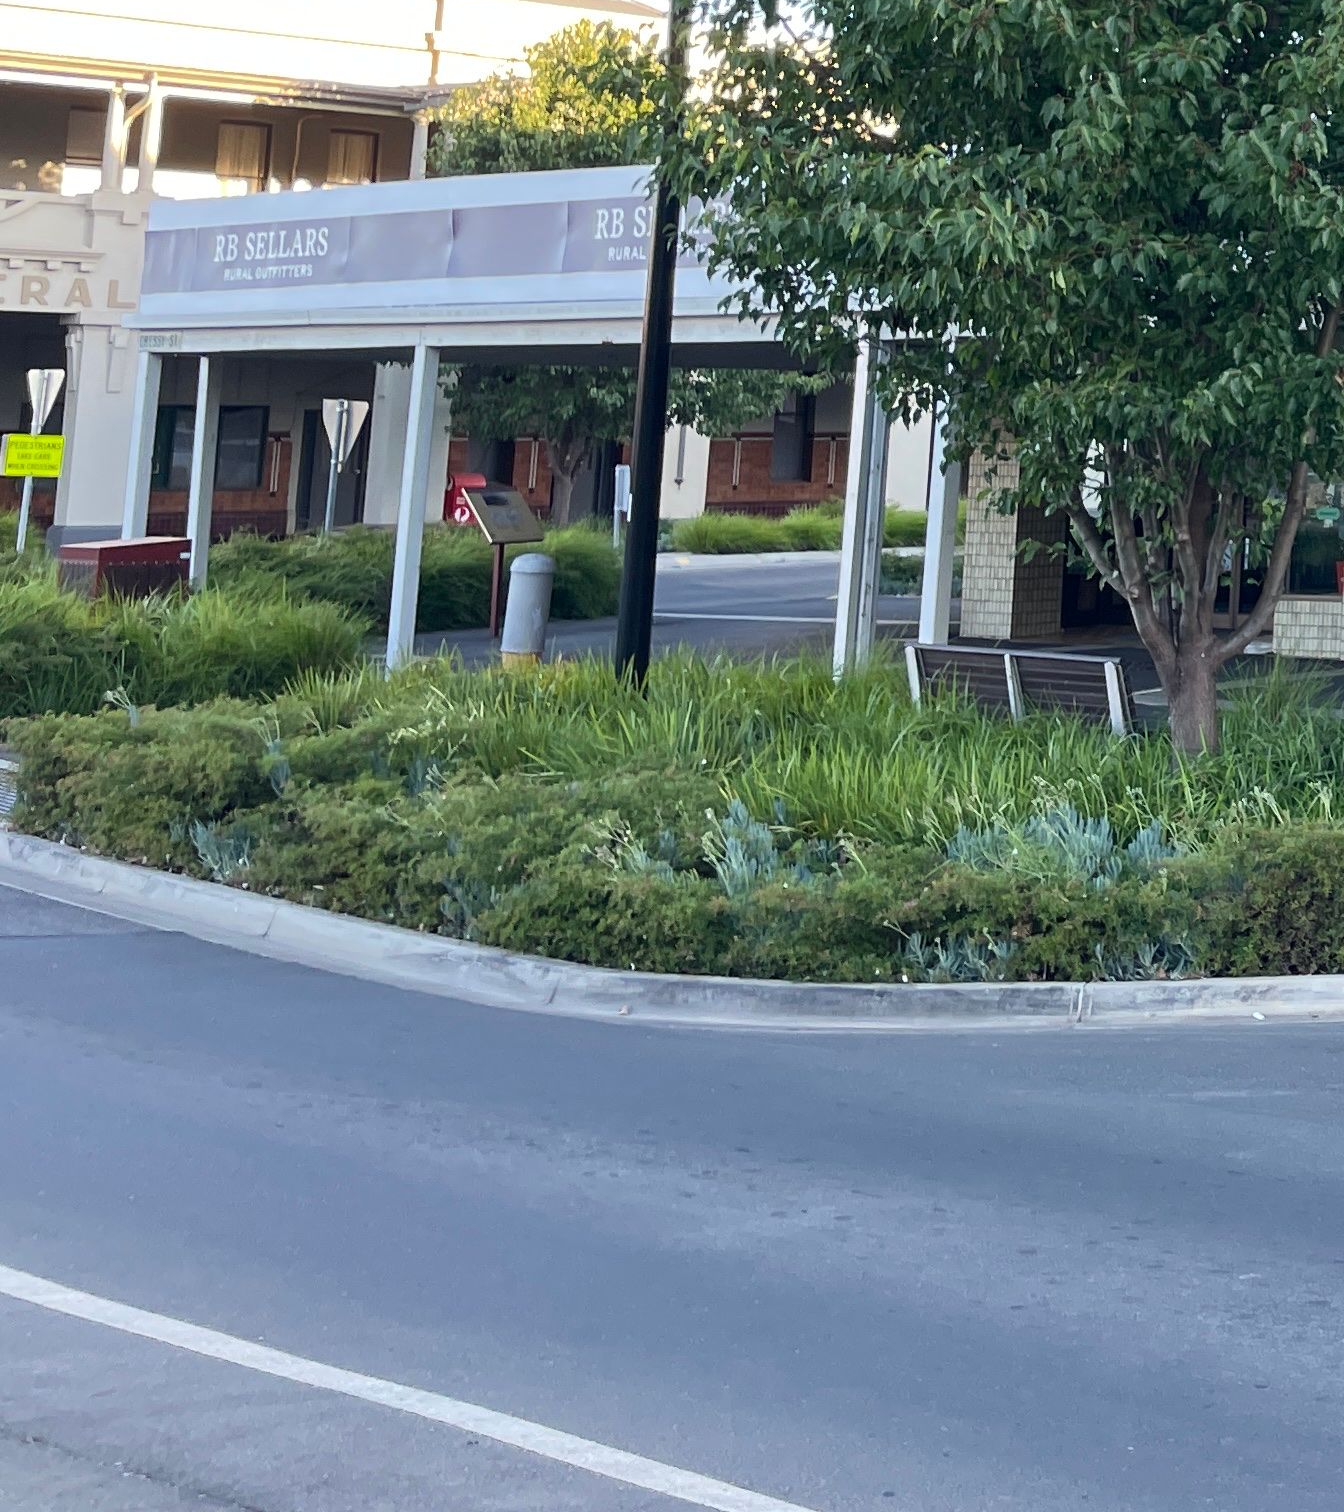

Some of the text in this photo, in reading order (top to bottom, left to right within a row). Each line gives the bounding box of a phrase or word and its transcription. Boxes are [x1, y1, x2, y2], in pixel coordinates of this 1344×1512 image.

[594, 207, 625, 239] RB
[213, 227, 329, 262] RB SELLARS
[608, 246, 646, 262] RURAL
[223, 264, 313, 281] RURAL OUTFITTERS
[0, 273, 136, 309] RAL
